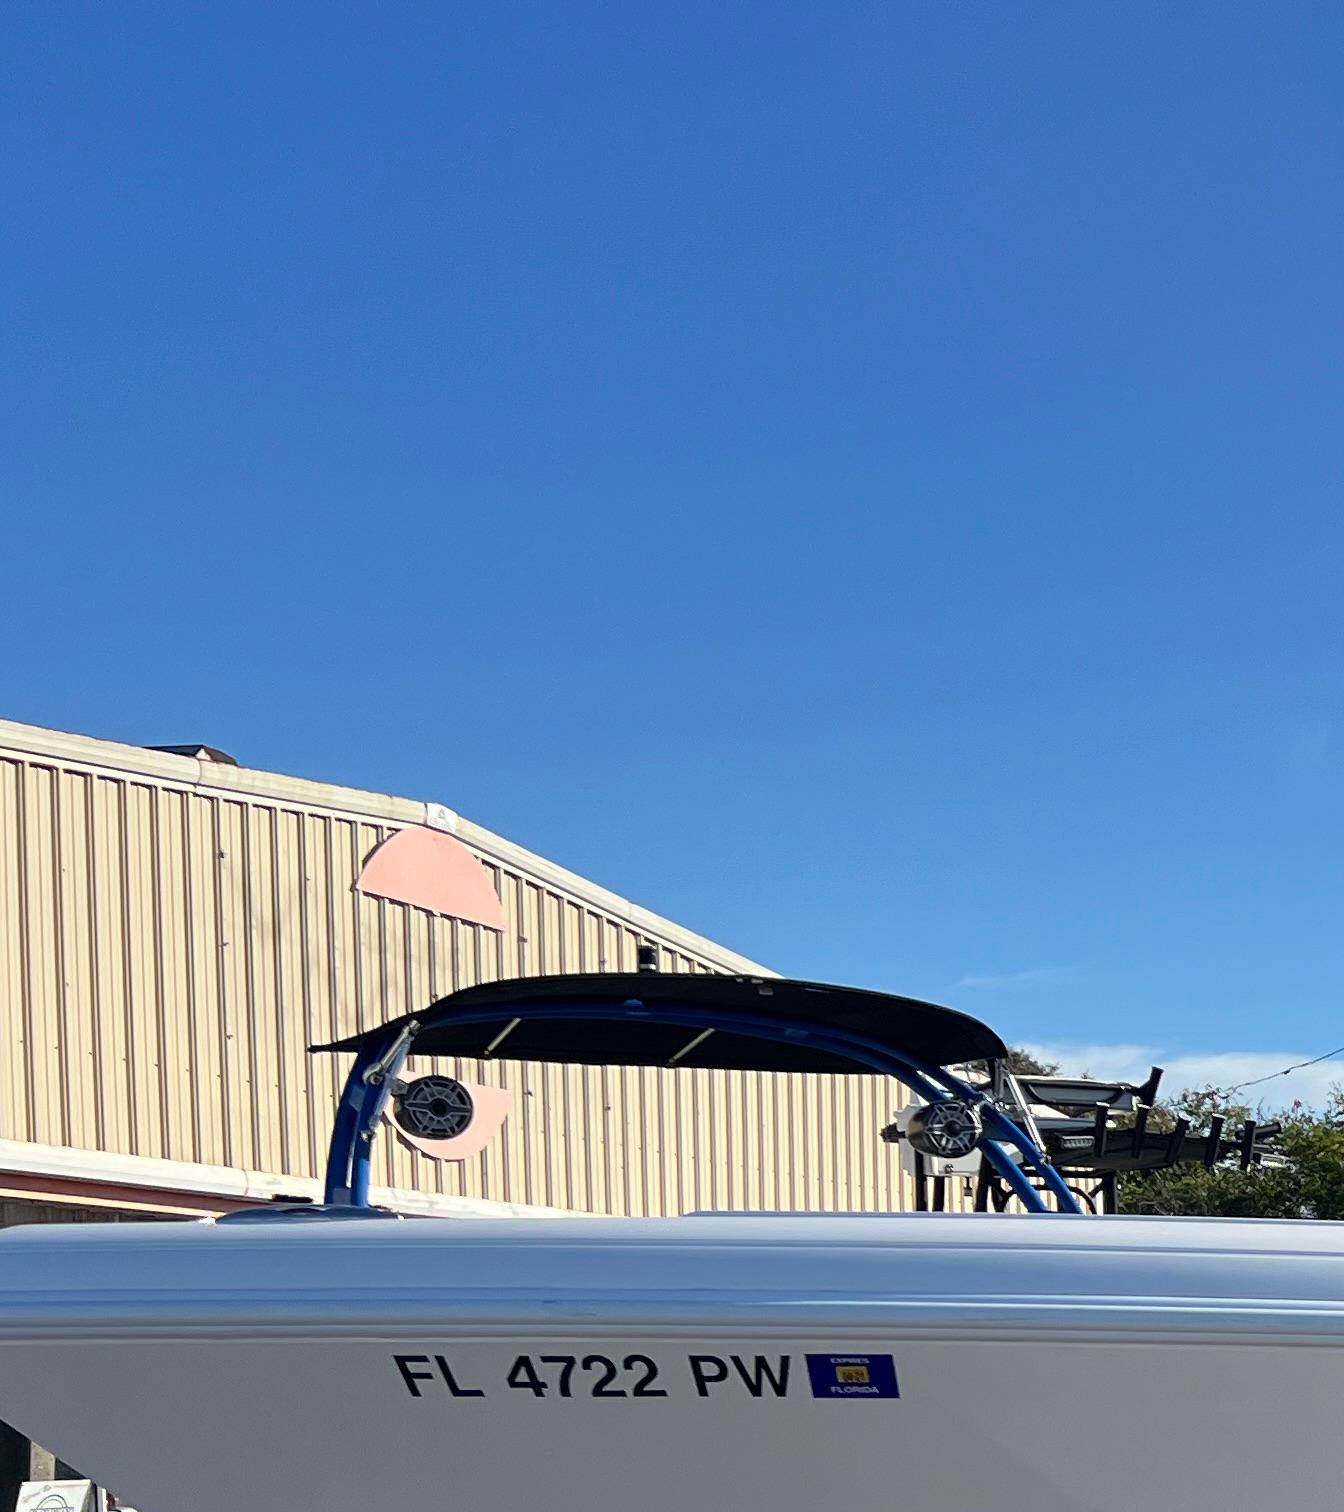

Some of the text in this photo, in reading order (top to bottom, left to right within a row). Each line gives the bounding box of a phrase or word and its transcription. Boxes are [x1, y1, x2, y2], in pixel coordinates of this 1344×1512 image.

[393, 1355, 791, 1397] FL 4722 PW
